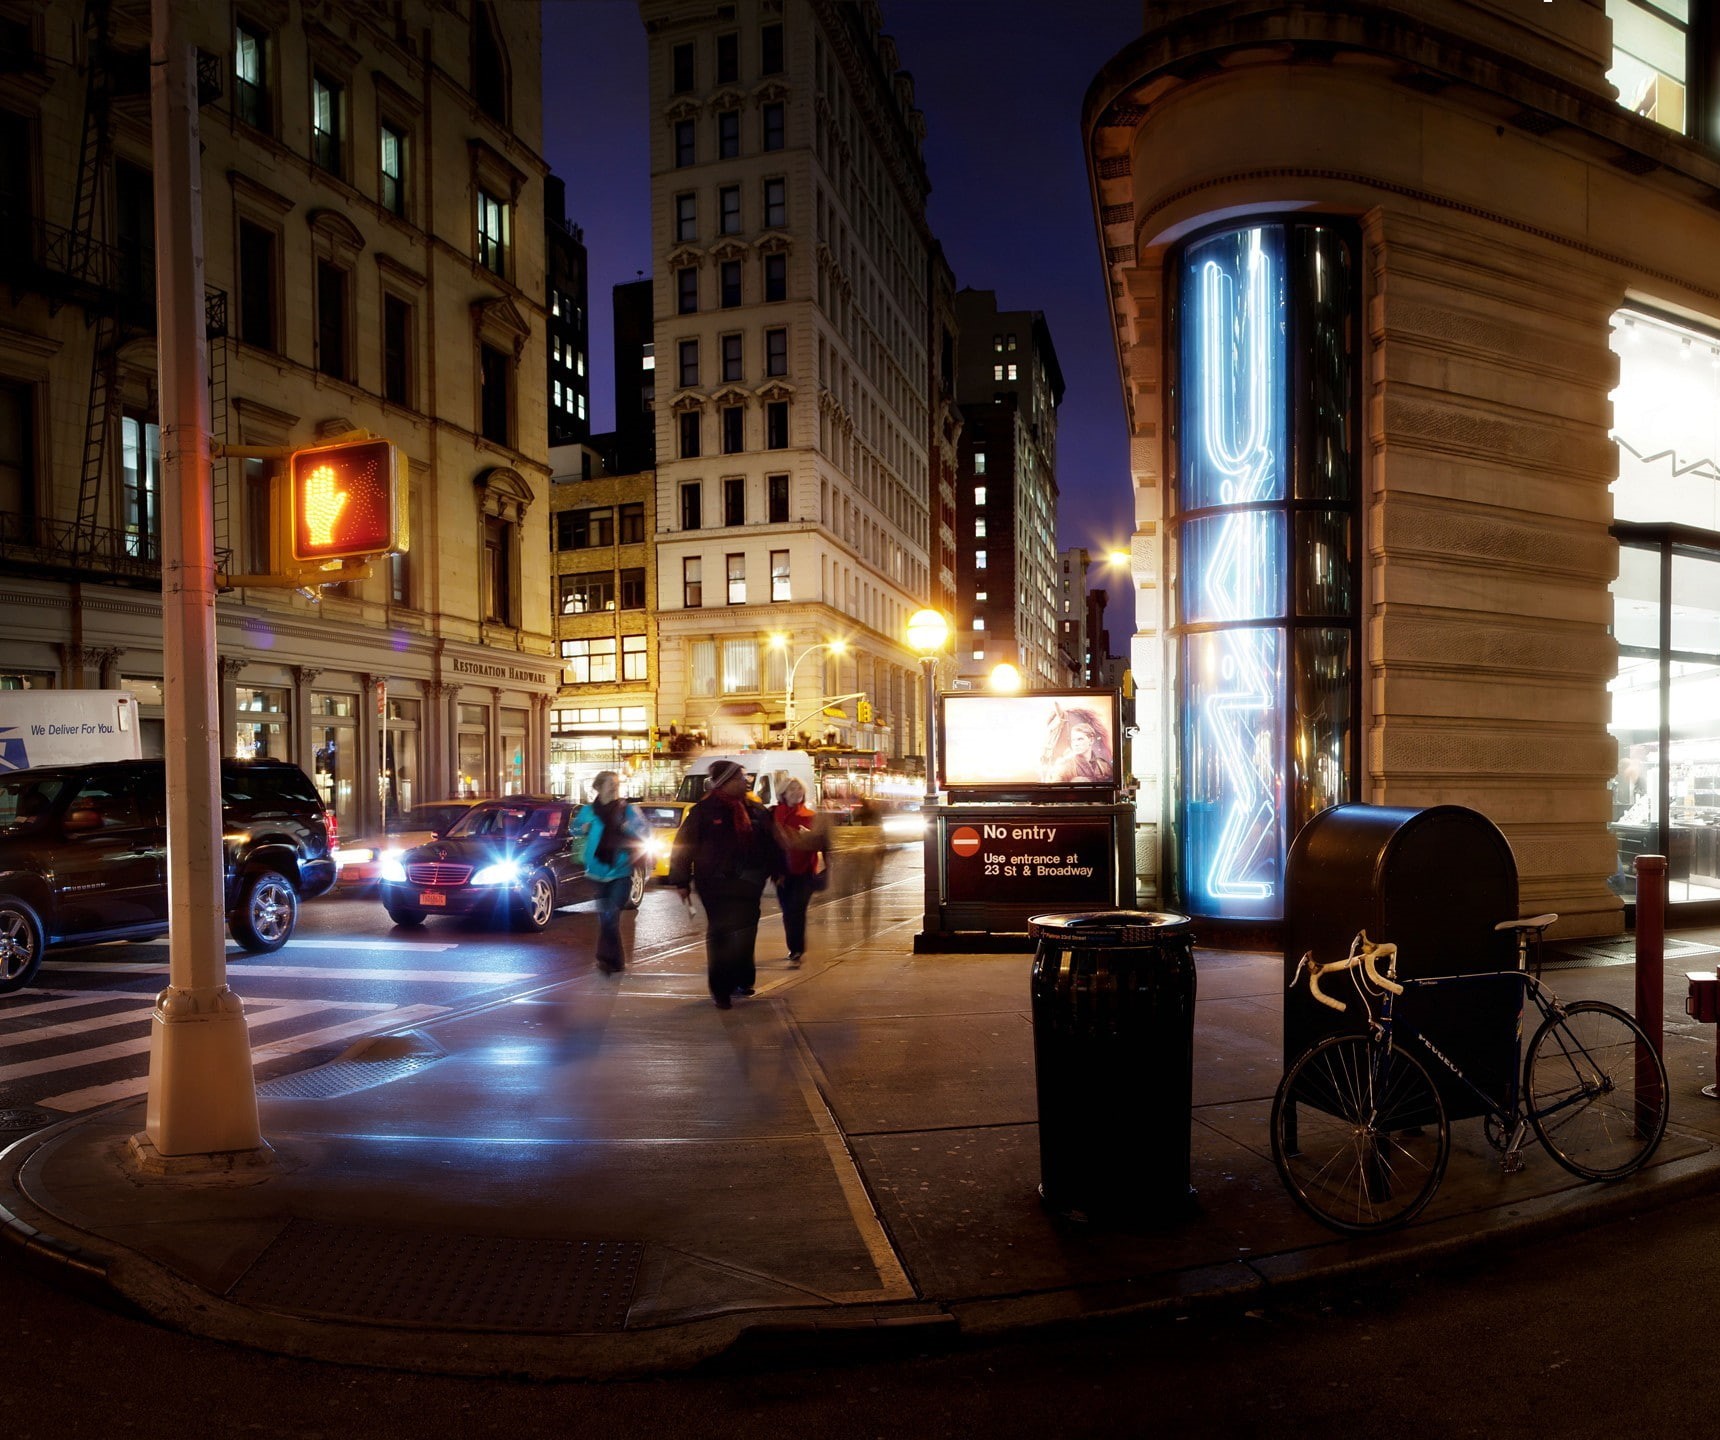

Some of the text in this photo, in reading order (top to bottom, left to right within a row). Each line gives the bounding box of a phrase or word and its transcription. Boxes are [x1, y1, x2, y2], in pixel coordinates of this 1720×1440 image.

[453, 659, 546, 683] RESTORATION HARDWARE
[31, 723, 114, 735] We Deliver For You.
[984, 825, 1056, 842] No entry
[984, 853, 1078, 864] Use entrance at
[984, 865, 1093, 877] 23 St & Broadway
